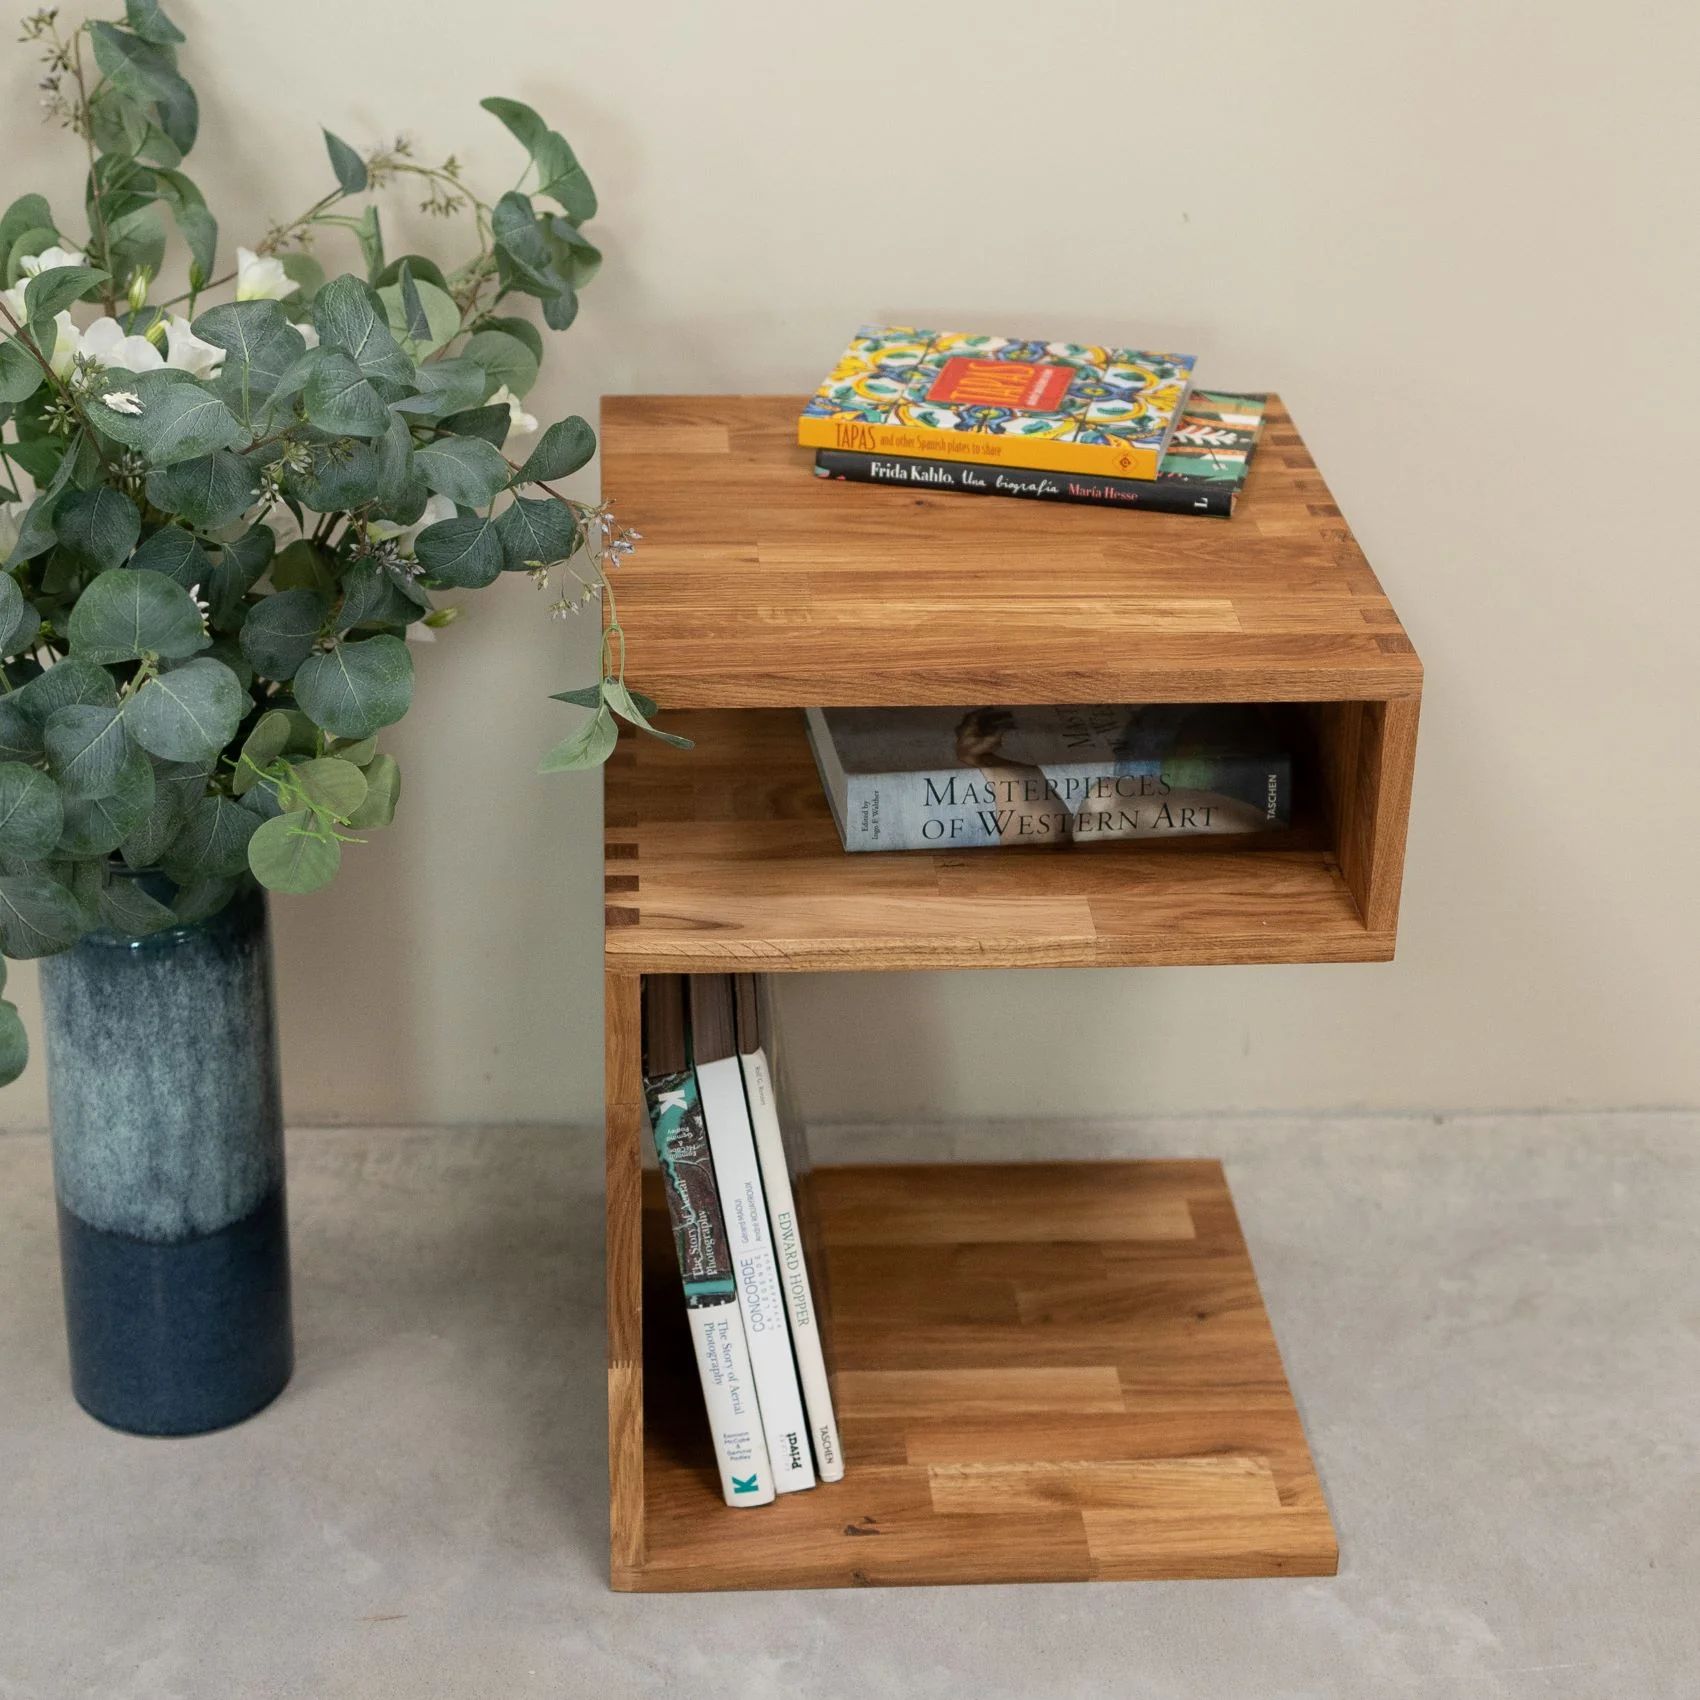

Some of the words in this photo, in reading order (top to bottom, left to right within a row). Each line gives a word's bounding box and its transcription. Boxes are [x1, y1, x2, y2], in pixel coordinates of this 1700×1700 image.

[950, 362, 1035, 403] TAPAS
[835, 423, 876, 450] TAPAS
[880, 435, 894, 447] and
[895, 435, 915, 449] other
[917, 435, 946, 452] Spanish
[947, 440, 970, 454] plates
[972, 443, 980, 455] to
[981, 444, 1002, 457] share
[870, 461, 908, 480] Frida
[910, 465, 954, 484] Kahlo.
[961, 469, 987, 487] Una
[995, 475, 1060, 496] biografía
[1068, 483, 1102, 498] María
[1103, 486, 1139, 501] Hesse
[861, 800, 871, 809] by
[923, 773, 1172, 807] MASTERPIECES
[1267, 774, 1277, 820] TASCHEN
[861, 810, 869, 832] Edited
[922, 818, 966, 840] OF
[975, 808, 1140, 838] WESTERN
[1151, 801, 1220, 830] ART
[658, 1089, 688, 1114] K
[688, 1228, 699, 1255] Story
[699, 1210, 718, 1276] Photography
[692, 1257, 704, 1278] The
[778, 1211, 799, 1271] EDWARD
[789, 1273, 810, 1327] HOPPER
[740, 1257, 766, 1333] CONCORDE
[717, 1319, 729, 1341] The
[703, 1322, 725, 1386] Photography
[722, 1342, 733, 1369] Story
[727, 1371, 737, 1382] of
[729, 1385, 745, 1415] Aerial
[819, 1424, 835, 1465] TASCHEN
[731, 1473, 760, 1494] K
